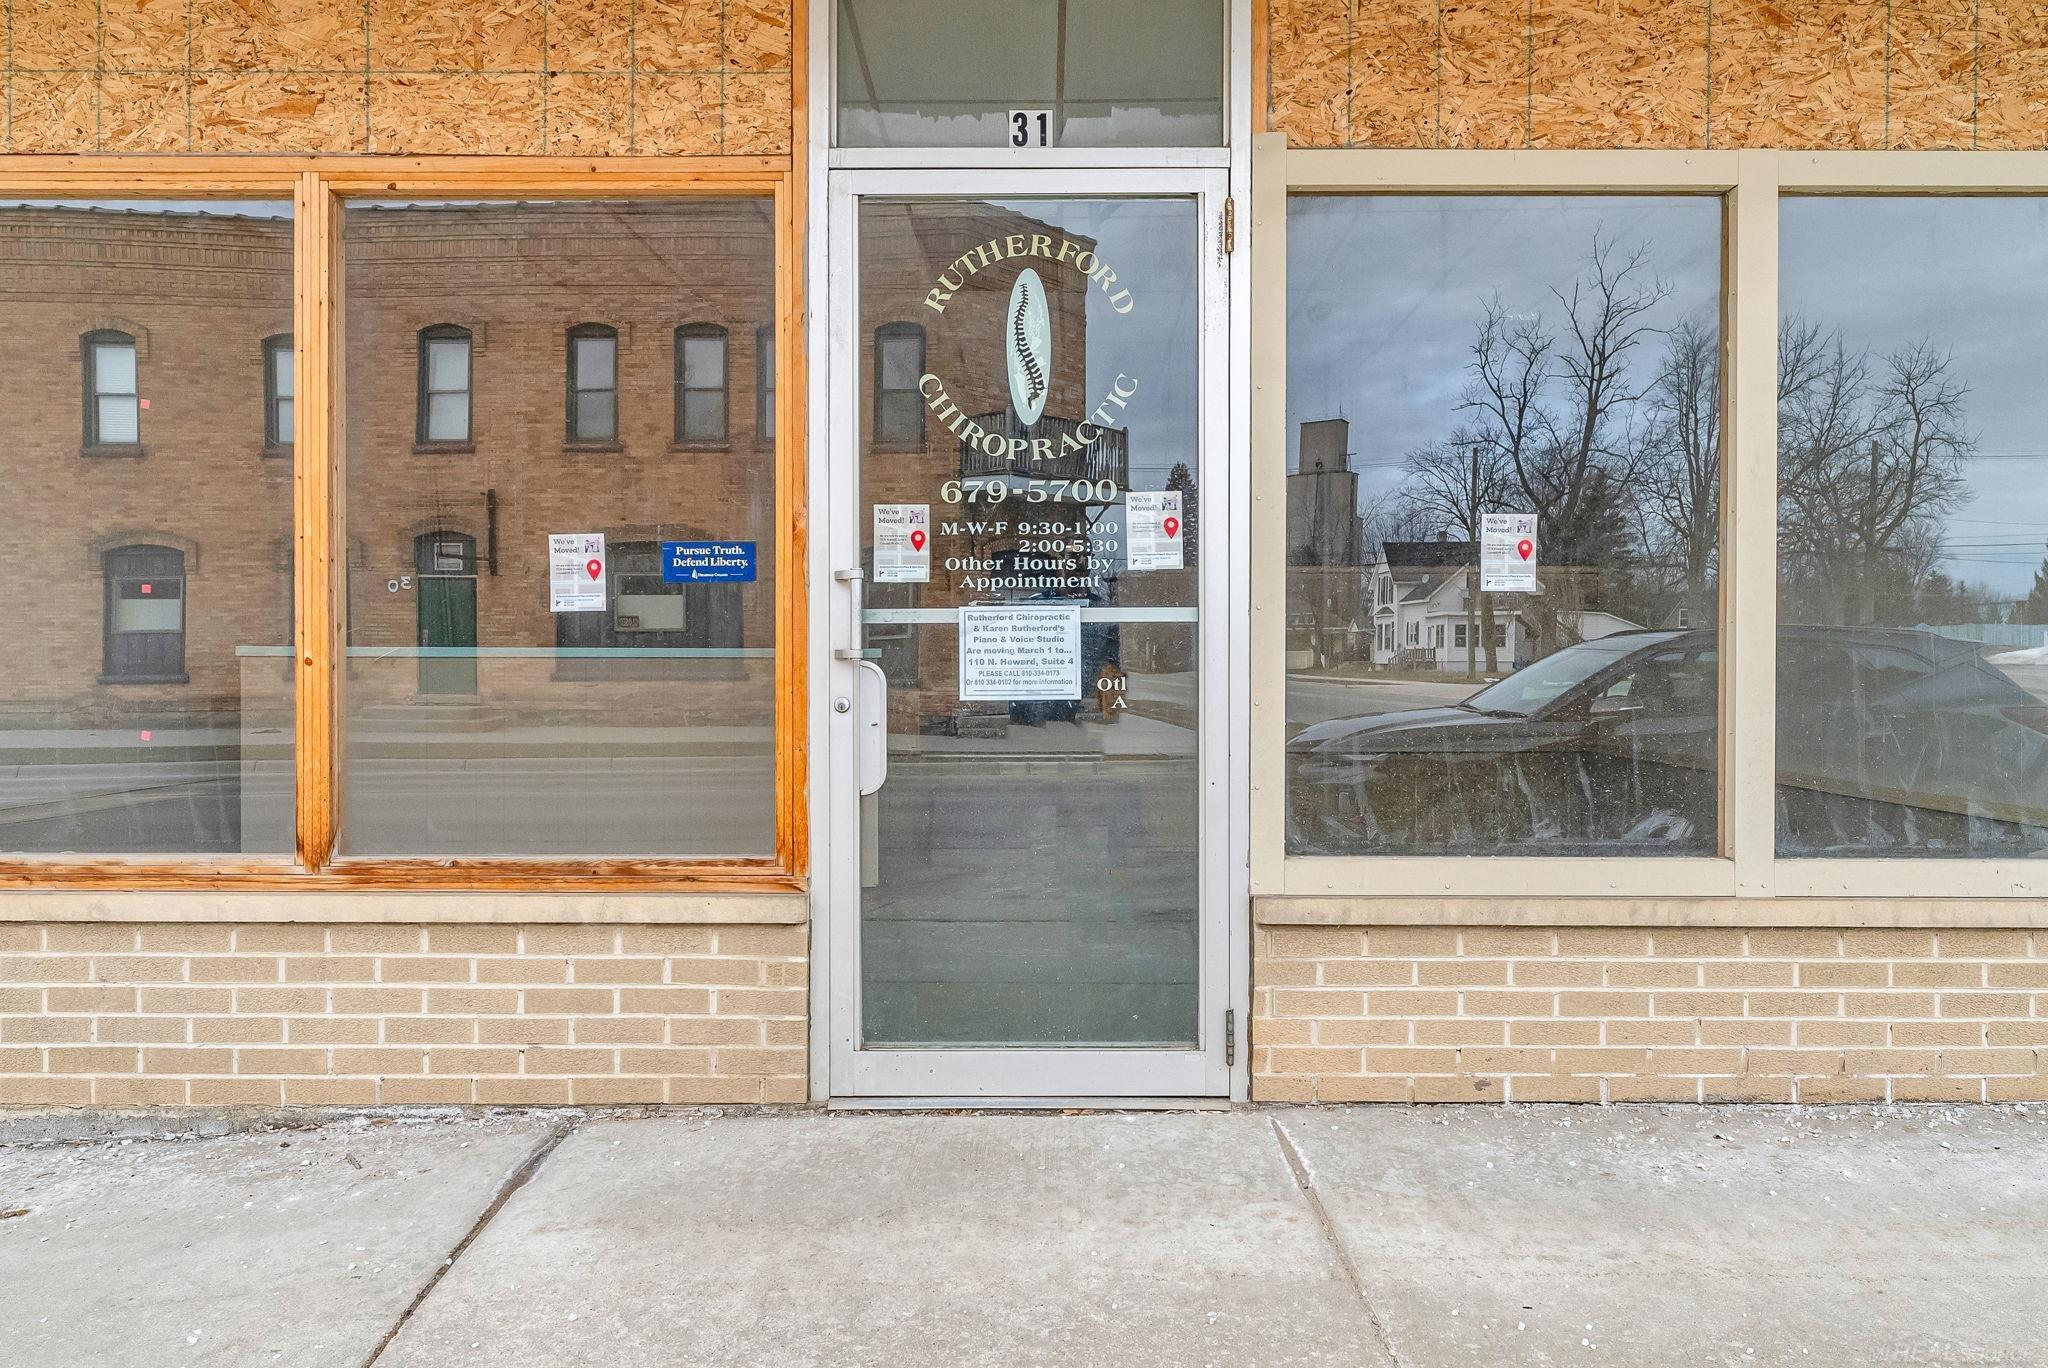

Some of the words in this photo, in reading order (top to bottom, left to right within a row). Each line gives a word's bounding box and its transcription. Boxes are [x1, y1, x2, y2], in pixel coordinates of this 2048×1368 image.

[1012, 111, 1047, 147] 31
[923, 234, 1134, 315] RUTHERFORD
[918, 372, 1138, 460] CHIROPRACTIC
[940, 479, 1118, 504] 679-5700
[1130, 495, 1152, 503] We've
[878, 507, 900, 515] We've
[1486, 517, 1508, 525] We've
[940, 522, 1009, 536] M-W-F
[1018, 522, 1118, 535] 9:30-1:00
[675, 546, 711, 555] Pursue
[712, 545, 745, 555] Truth.
[1019, 540, 1118, 552] 2:00-5:30
[672, 557, 709, 567] Defend
[710, 557, 749, 569] Liberty.
[945, 556, 1004, 570] Other
[1013, 557, 1077, 570] Hours
[1086, 556, 1113, 573] by
[960, 574, 1100, 591] Appointment
[1016, 613, 1071, 622] Chiropractic
[1011, 624, 1065, 632] Rutherford's
[1036, 635, 1065, 643] Studio
[984, 647, 1015, 656] moving
[1055, 646, 1072, 654] to...
[968, 658, 985, 666] 110
[987, 658, 998, 666] N.
[1000, 658, 1039, 666] Howard,
[1067, 657, 1074, 665] 4
[1111, 695, 1128, 709] A
